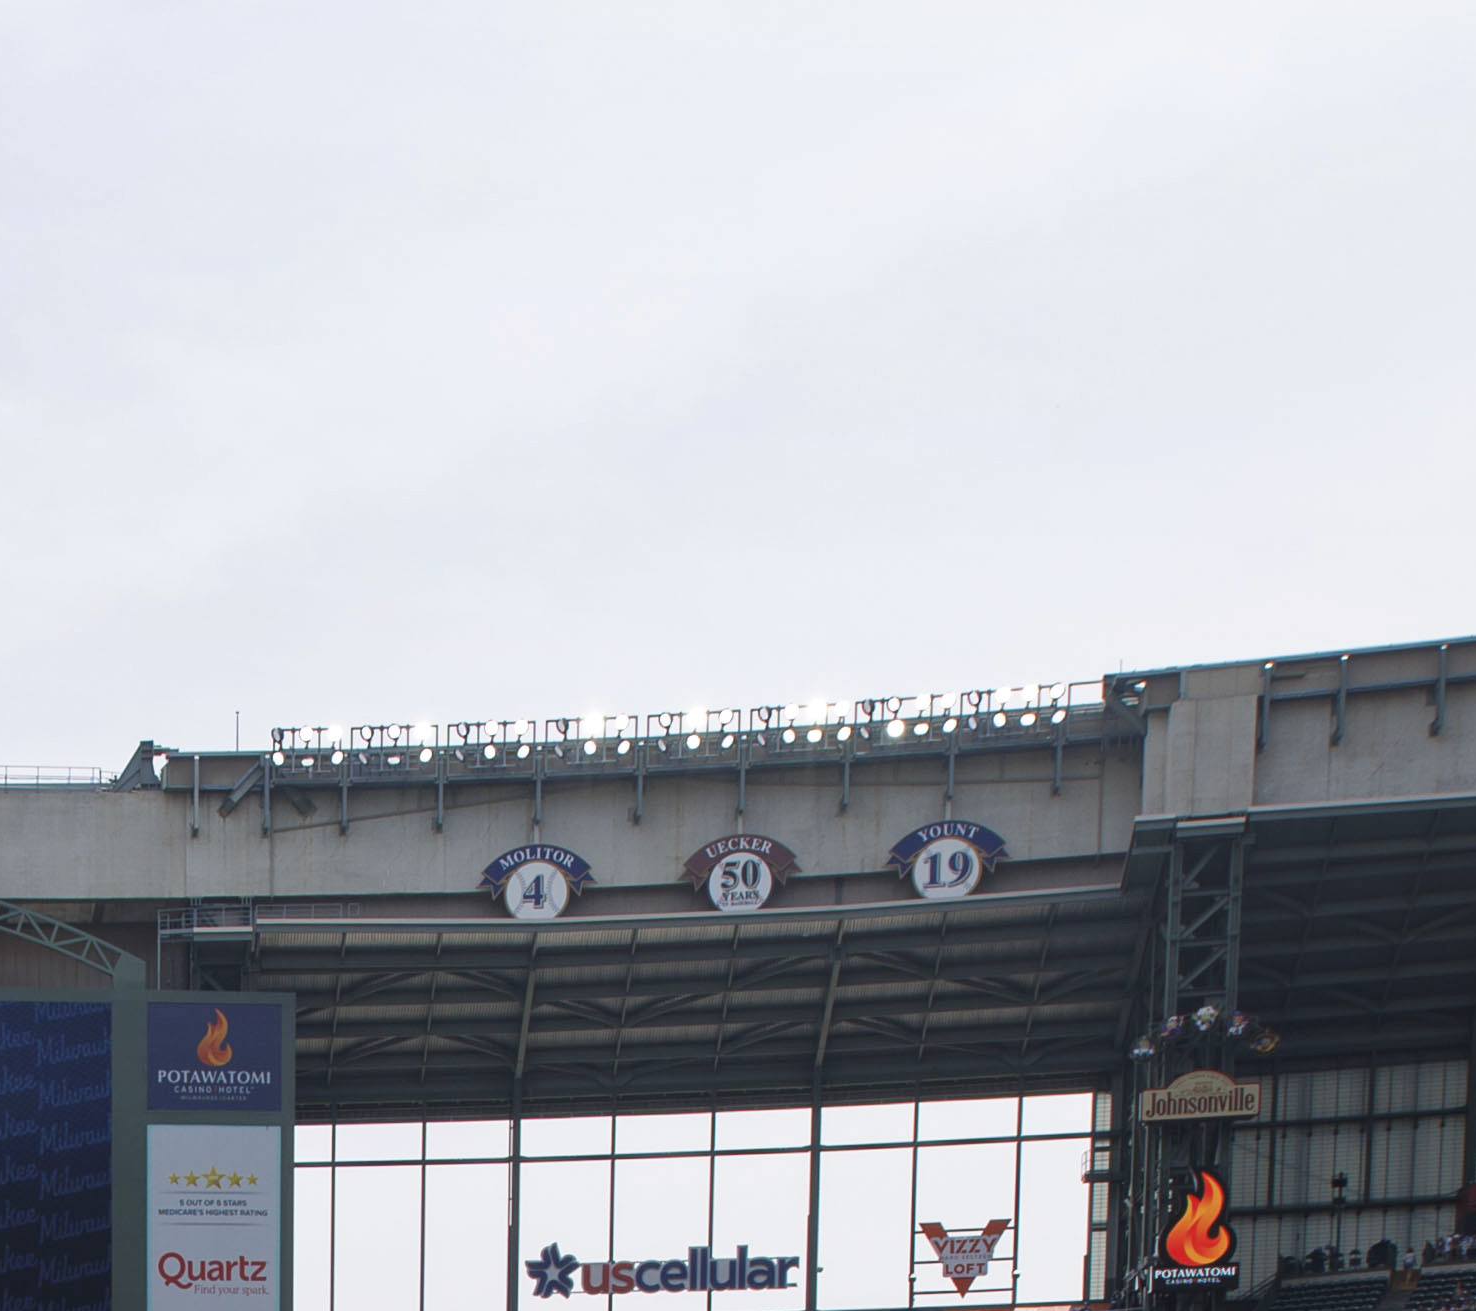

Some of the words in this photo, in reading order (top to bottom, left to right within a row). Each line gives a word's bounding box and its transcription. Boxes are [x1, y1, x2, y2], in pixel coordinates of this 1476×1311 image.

[916, 822, 980, 842] YOUNT
[705, 836, 773, 858] UECKER
[499, 848, 576, 872] MOLITOR
[920, 851, 970, 891] 19
[720, 858, 762, 891] 50
[521, 873, 548, 910] 4
[157, 1070, 271, 1085] POTAWATOMI
[1146, 1087, 1255, 1119] Johnsonville
[934, 1234, 999, 1255] VIZZY
[158, 1251, 268, 1290] Quartz
[945, 1262, 988, 1276] LOFT
[1154, 1265, 1237, 1280] POTAWATOMI
